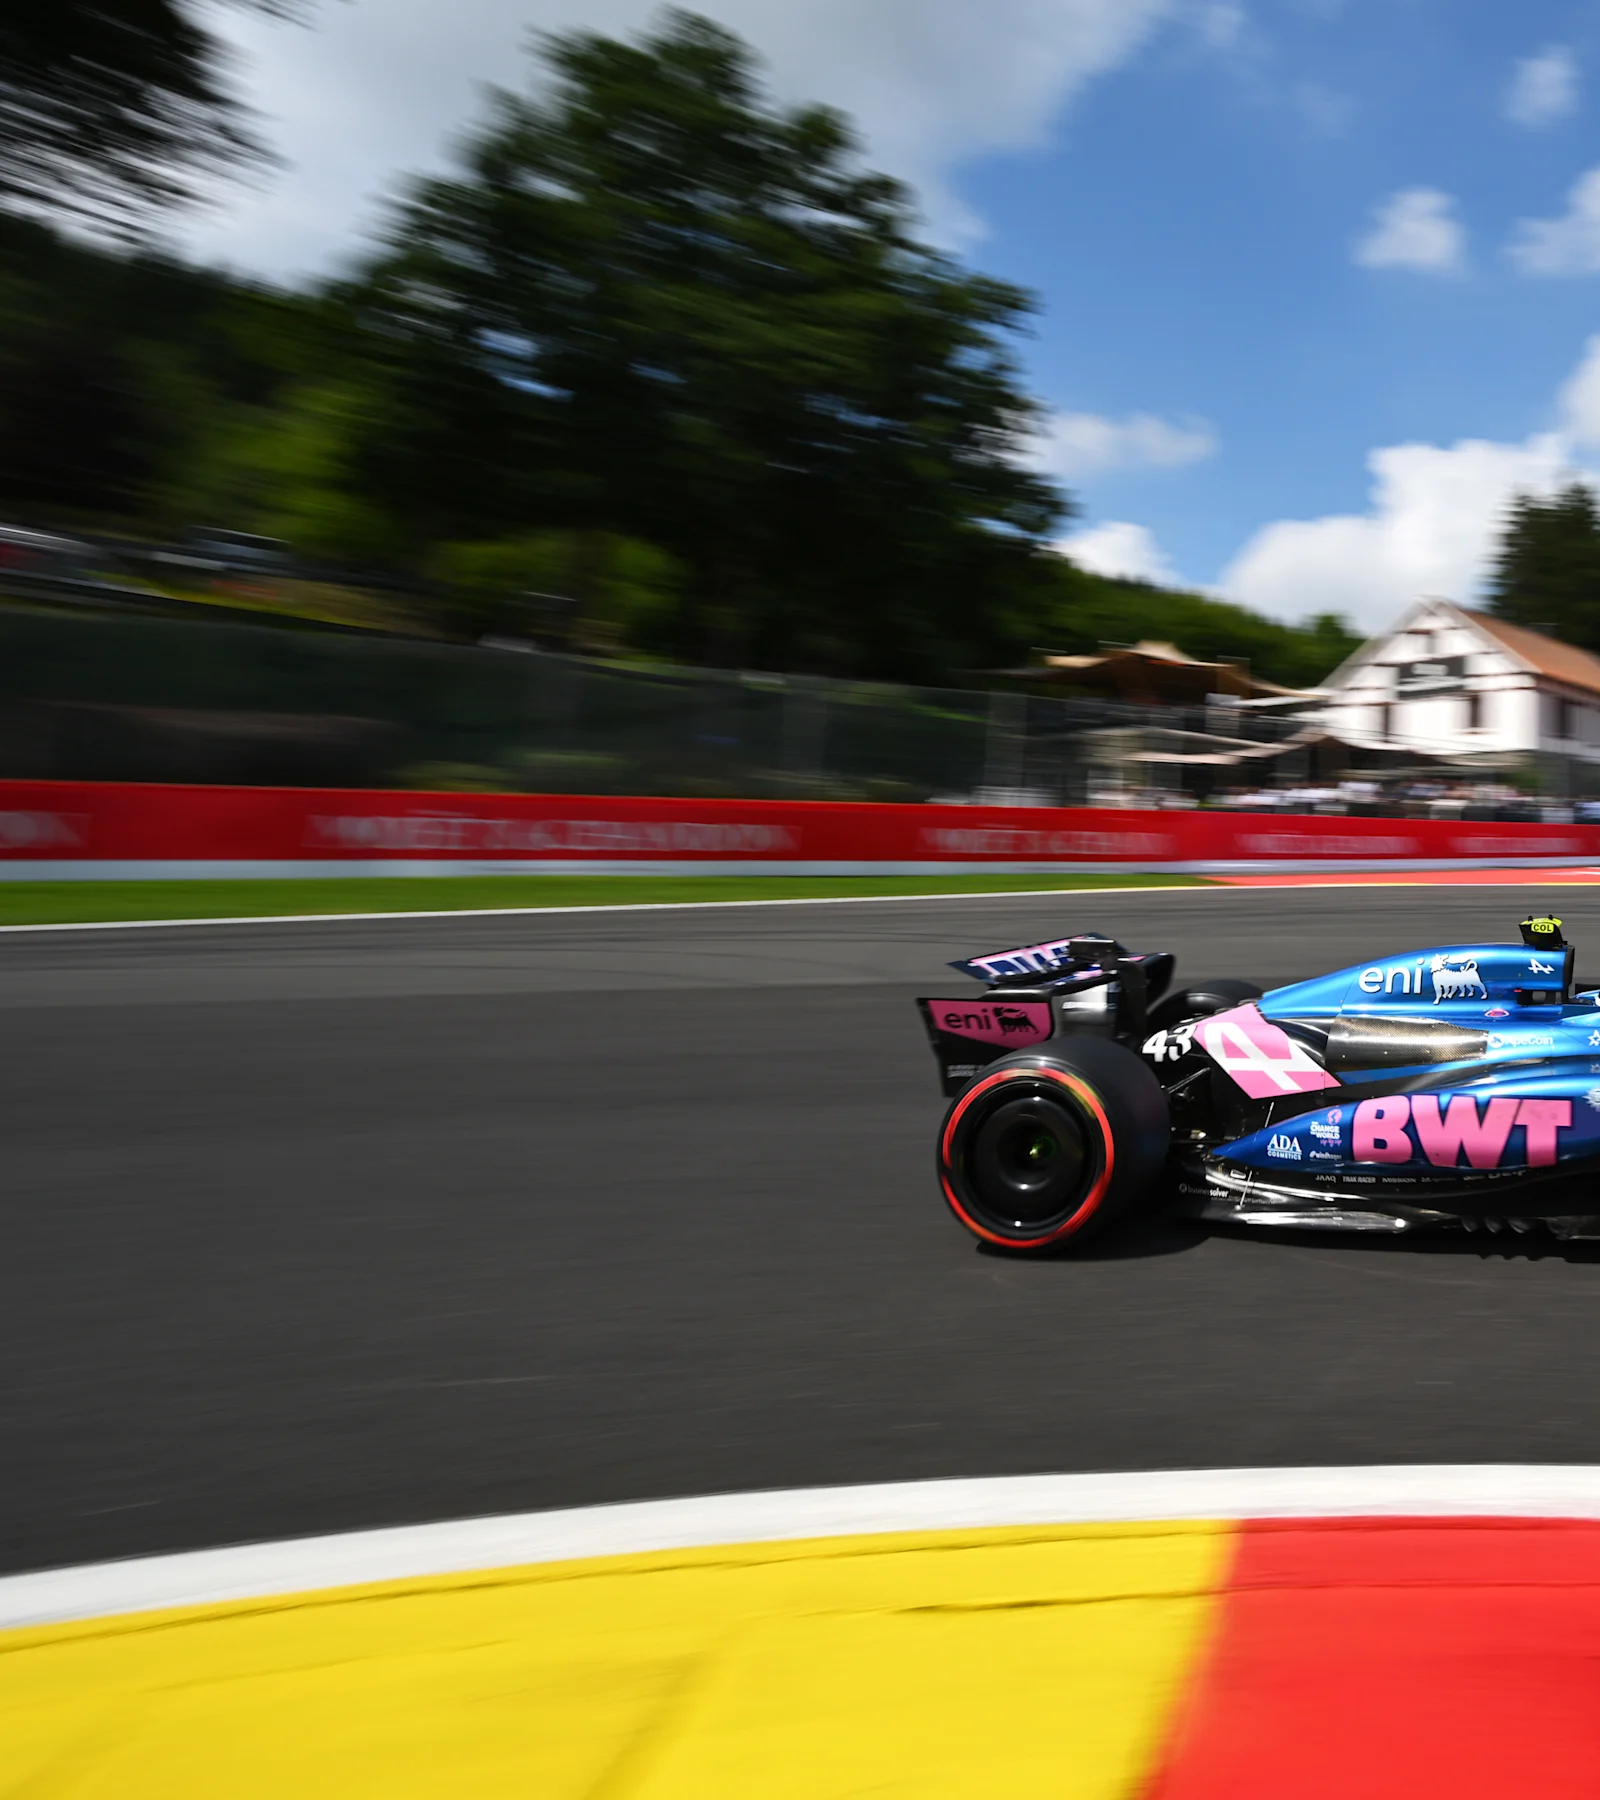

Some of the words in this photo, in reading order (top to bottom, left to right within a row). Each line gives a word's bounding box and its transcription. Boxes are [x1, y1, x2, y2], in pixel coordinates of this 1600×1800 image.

[1533, 924, 1552, 932] COL
[1358, 957, 1425, 994] eni
[944, 1009, 991, 1030] eni
[1142, 1025, 1198, 1062] 43
[1504, 1035, 1554, 1047] ApeCoin
[1352, 1095, 1572, 1169] BWT
[1267, 1133, 1302, 1153] ADA
[1267, 1150, 1302, 1160] COSMETICS
